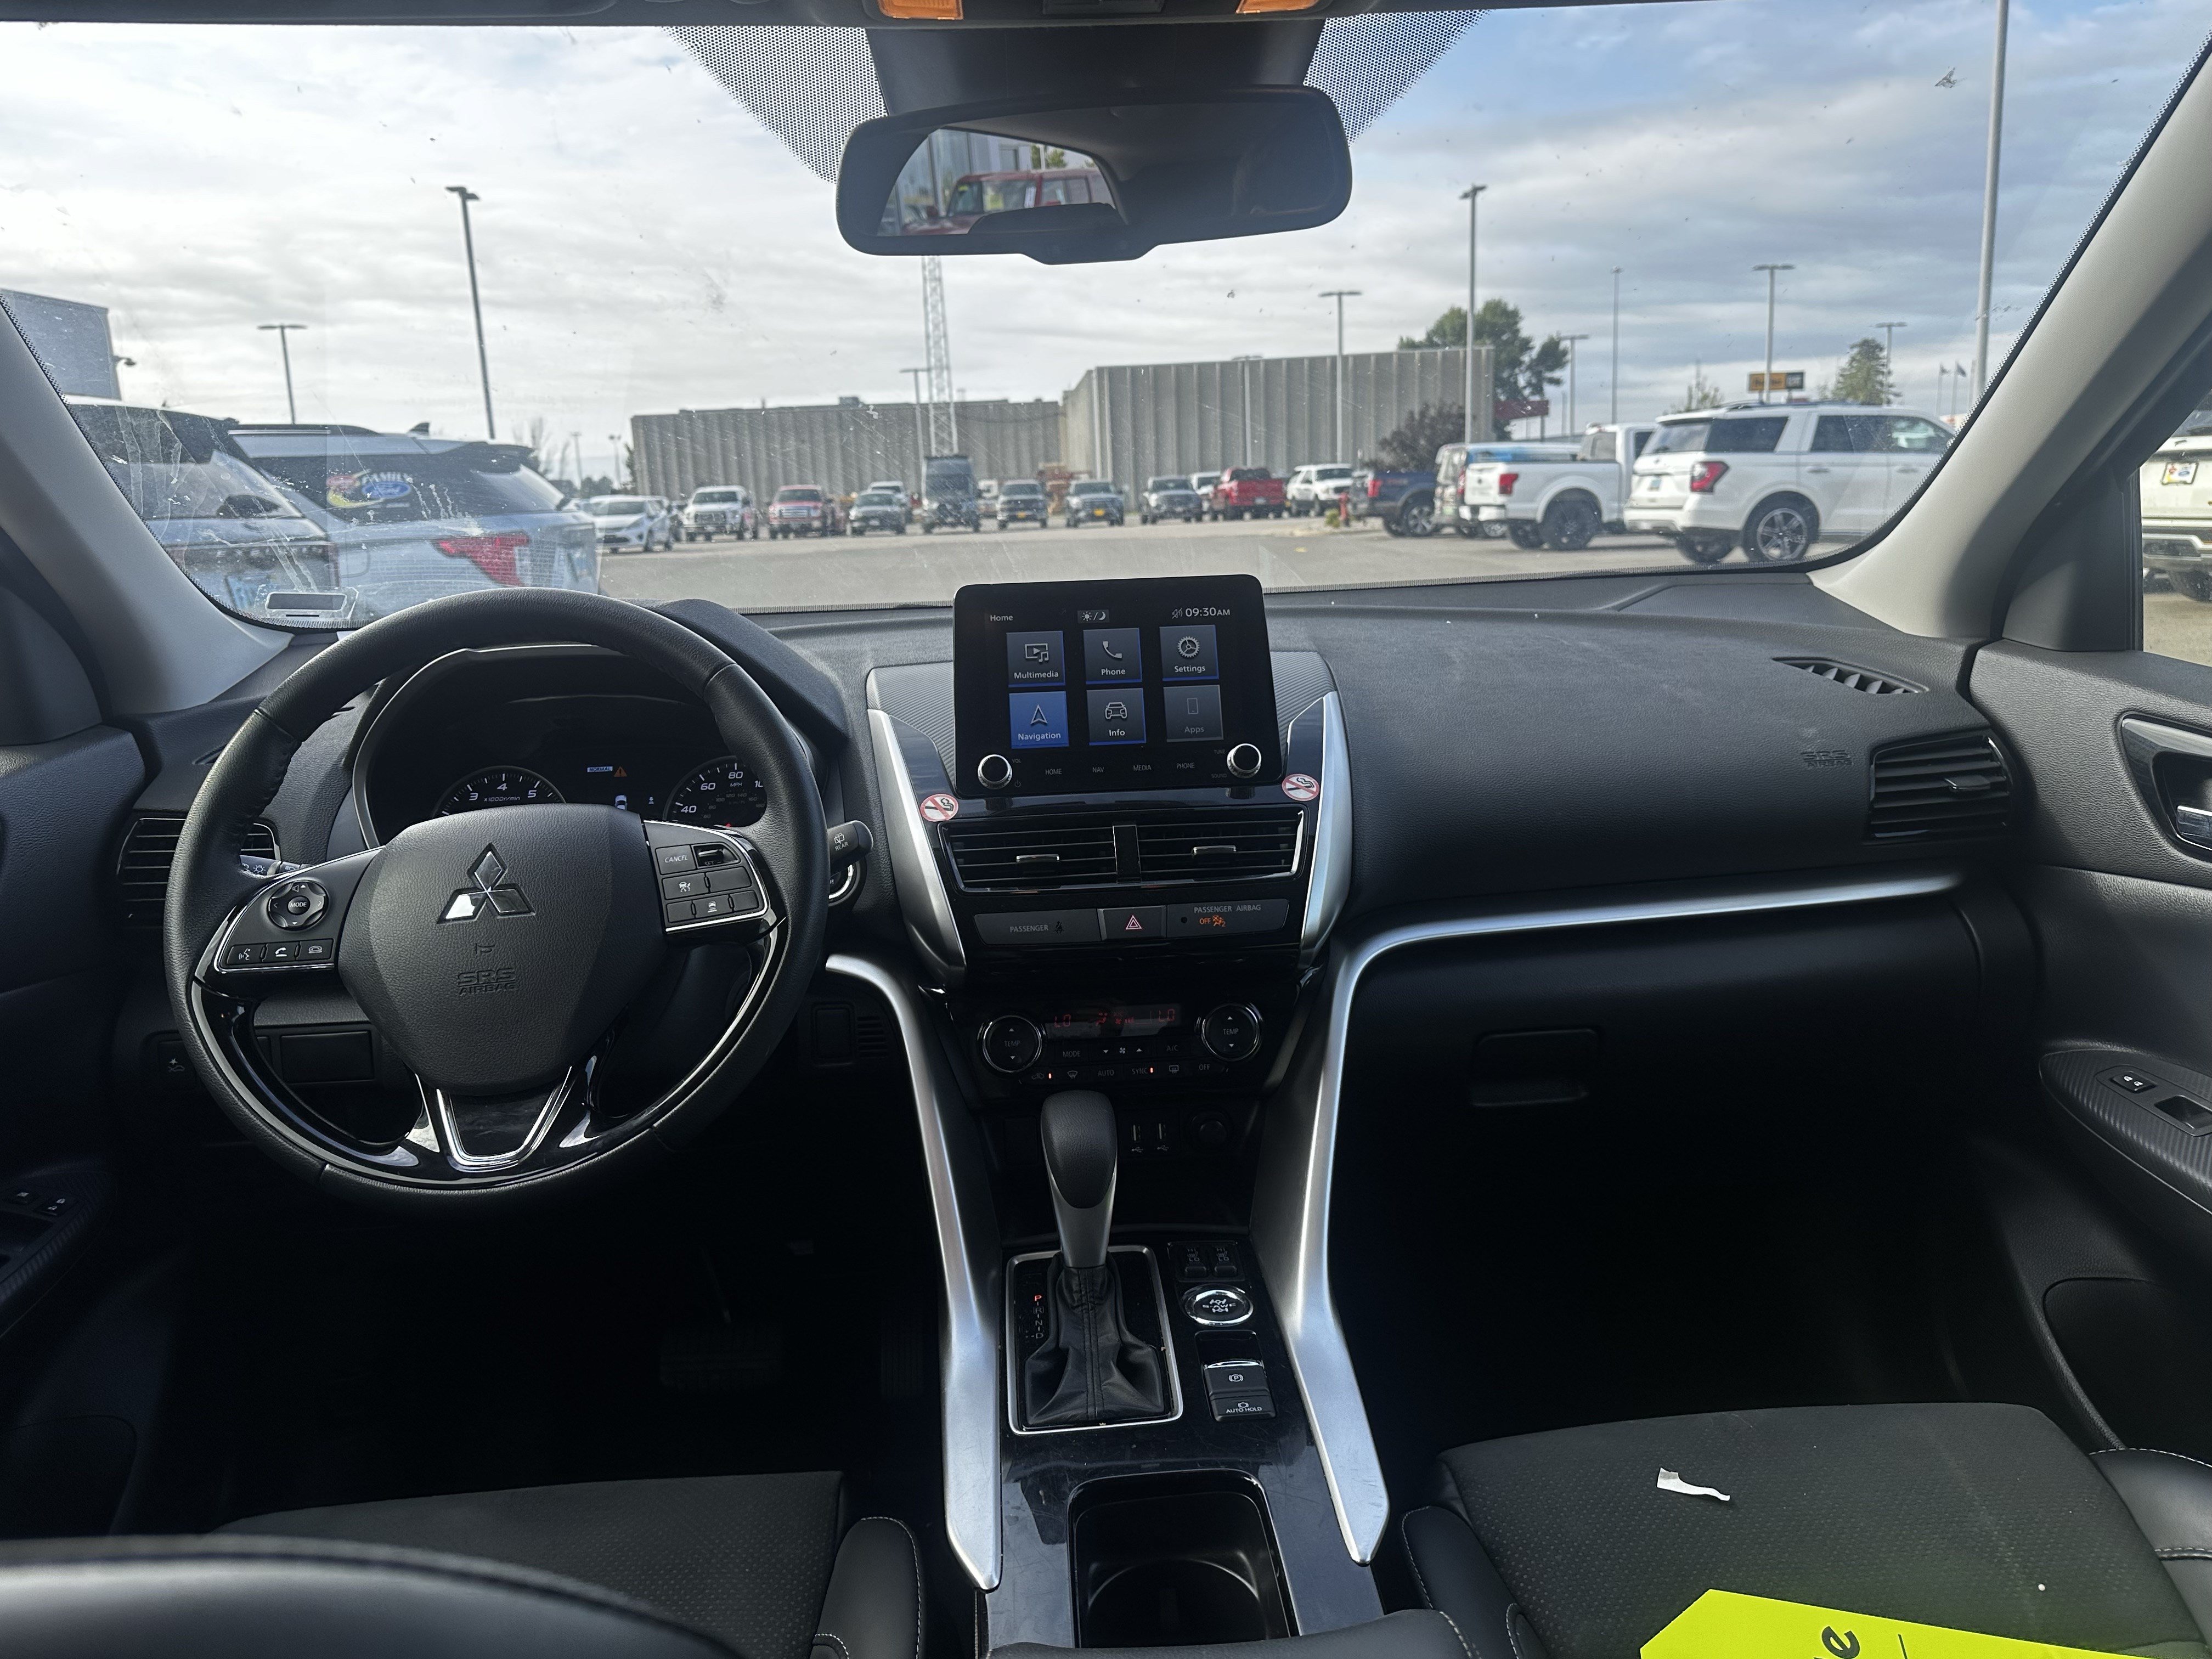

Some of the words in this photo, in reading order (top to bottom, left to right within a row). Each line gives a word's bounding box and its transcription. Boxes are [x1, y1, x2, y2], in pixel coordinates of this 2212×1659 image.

[1185, 607, 1231, 617] 09:30AM
[1174, 665, 1206, 673] Settings
[1014, 670, 1059, 679] Multimedia
[1109, 729, 1125, 737] Info
[1184, 726, 1205, 734] Apps
[1018, 732, 1061, 741] Navigation
[497, 783, 507, 791] 4
[700, 782, 716, 791] 60
[469, 792, 478, 801] 3
[528, 789, 537, 798] 5
[834, 842, 849, 851] REAR
[664, 855, 688, 863] CANCEL
[1194, 905, 1232, 913] PASSENGER
[1236, 904, 1261, 912] AIRBAG
[1009, 924, 1048, 933] PASSENGER
[458, 968, 516, 986] SRS
[1063, 1050, 1081, 1058] MODE
